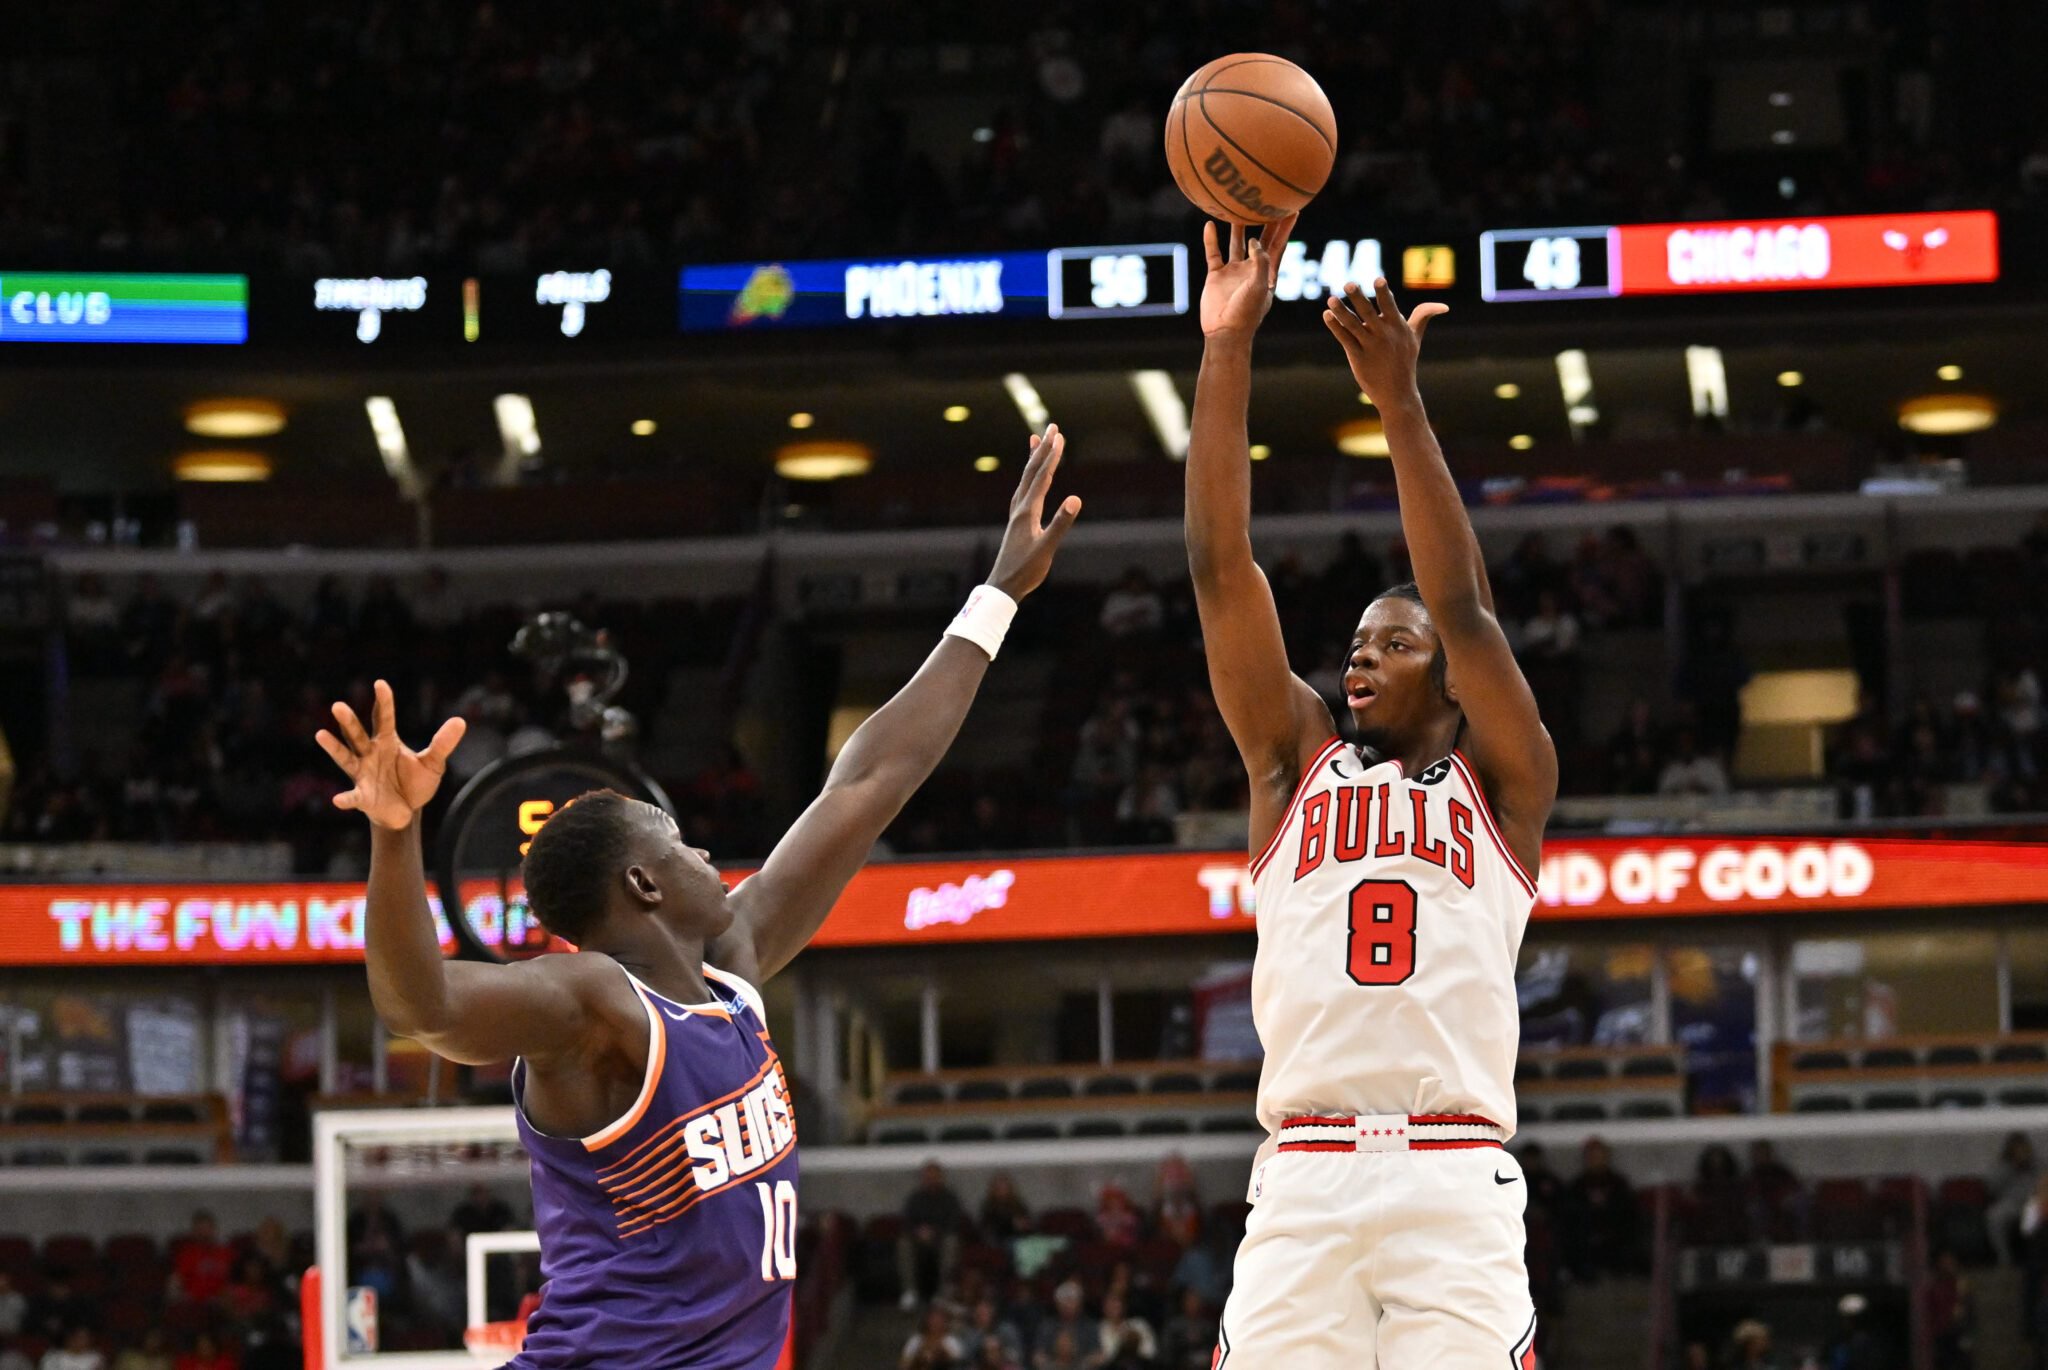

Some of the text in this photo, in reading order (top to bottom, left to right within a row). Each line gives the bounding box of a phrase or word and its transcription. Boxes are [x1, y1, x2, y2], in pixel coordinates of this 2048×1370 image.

[1667, 223, 1831, 285] CHICAGO
[10, 290, 112, 325] CLUB
[846, 259, 1003, 319] PHOENIX
[1293, 782, 1475, 890] BULLS
[1609, 847, 1697, 904] OF
[1700, 842, 1873, 900] GOOD
[49, 899, 170, 951] THE
[175, 899, 300, 951] FUN
[1345, 878, 1418, 986] 8
[684, 1066, 793, 1191] SUNS
[755, 1180, 797, 1280] 10
